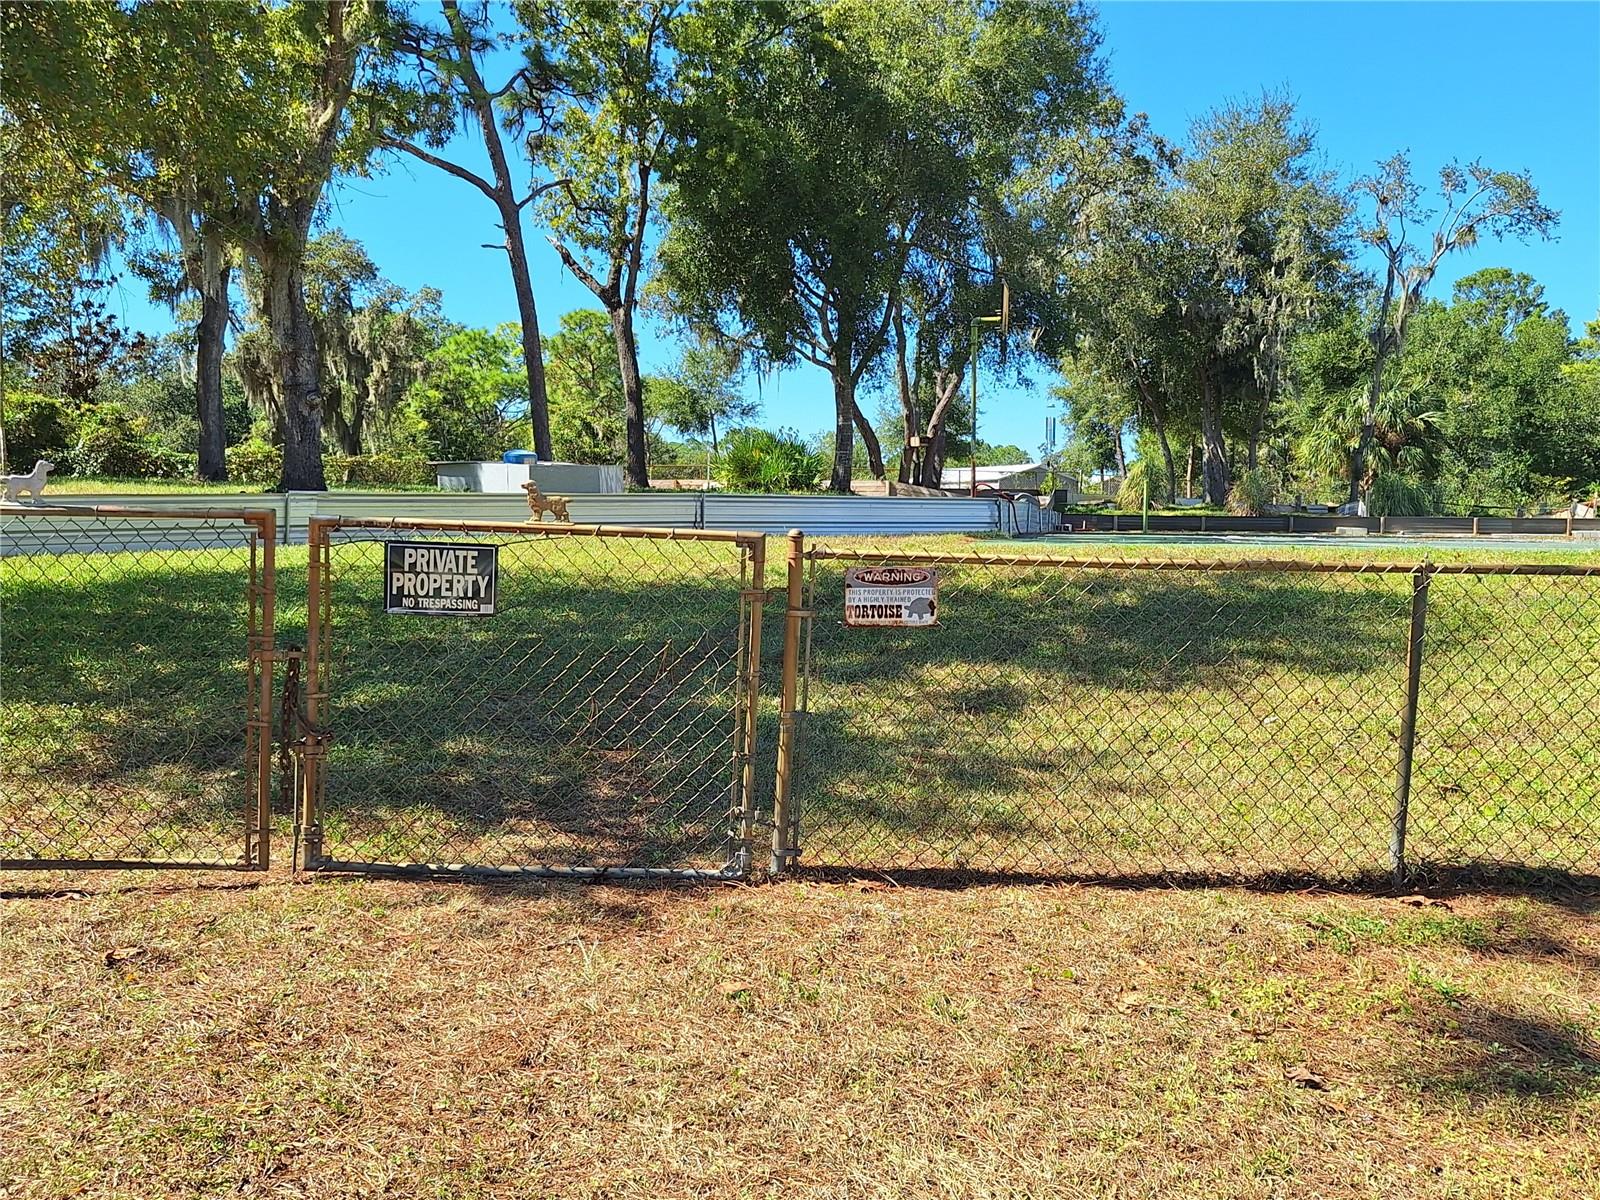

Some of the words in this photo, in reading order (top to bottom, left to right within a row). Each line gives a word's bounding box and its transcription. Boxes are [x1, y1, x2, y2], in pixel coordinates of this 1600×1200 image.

[404, 548, 478, 574] PRIVATE
[863, 572, 921, 582] WARNING
[392, 572, 489, 598] PROPERTY
[402, 597, 415, 608] NO
[417, 597, 478, 610] TRESPASSING
[847, 604, 902, 619] TORTOISE
